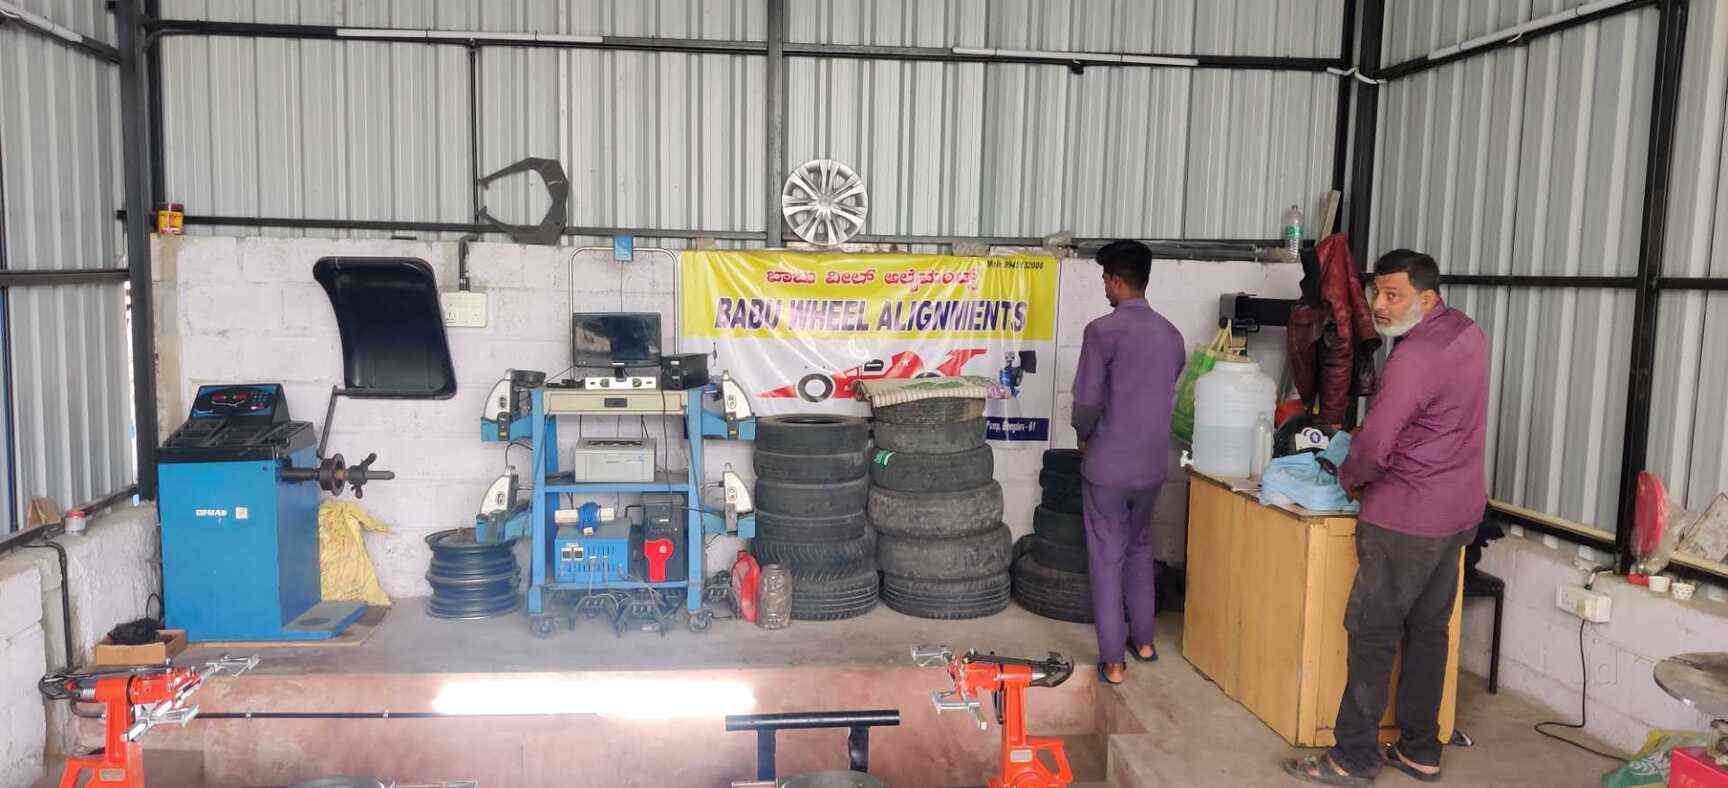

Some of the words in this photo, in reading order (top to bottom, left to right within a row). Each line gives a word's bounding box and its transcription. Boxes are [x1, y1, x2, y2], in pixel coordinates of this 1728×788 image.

[714, 296, 783, 330] BABU
[788, 298, 870, 332] WHEEL
[876, 299, 1028, 333] ALIGNMENTS
